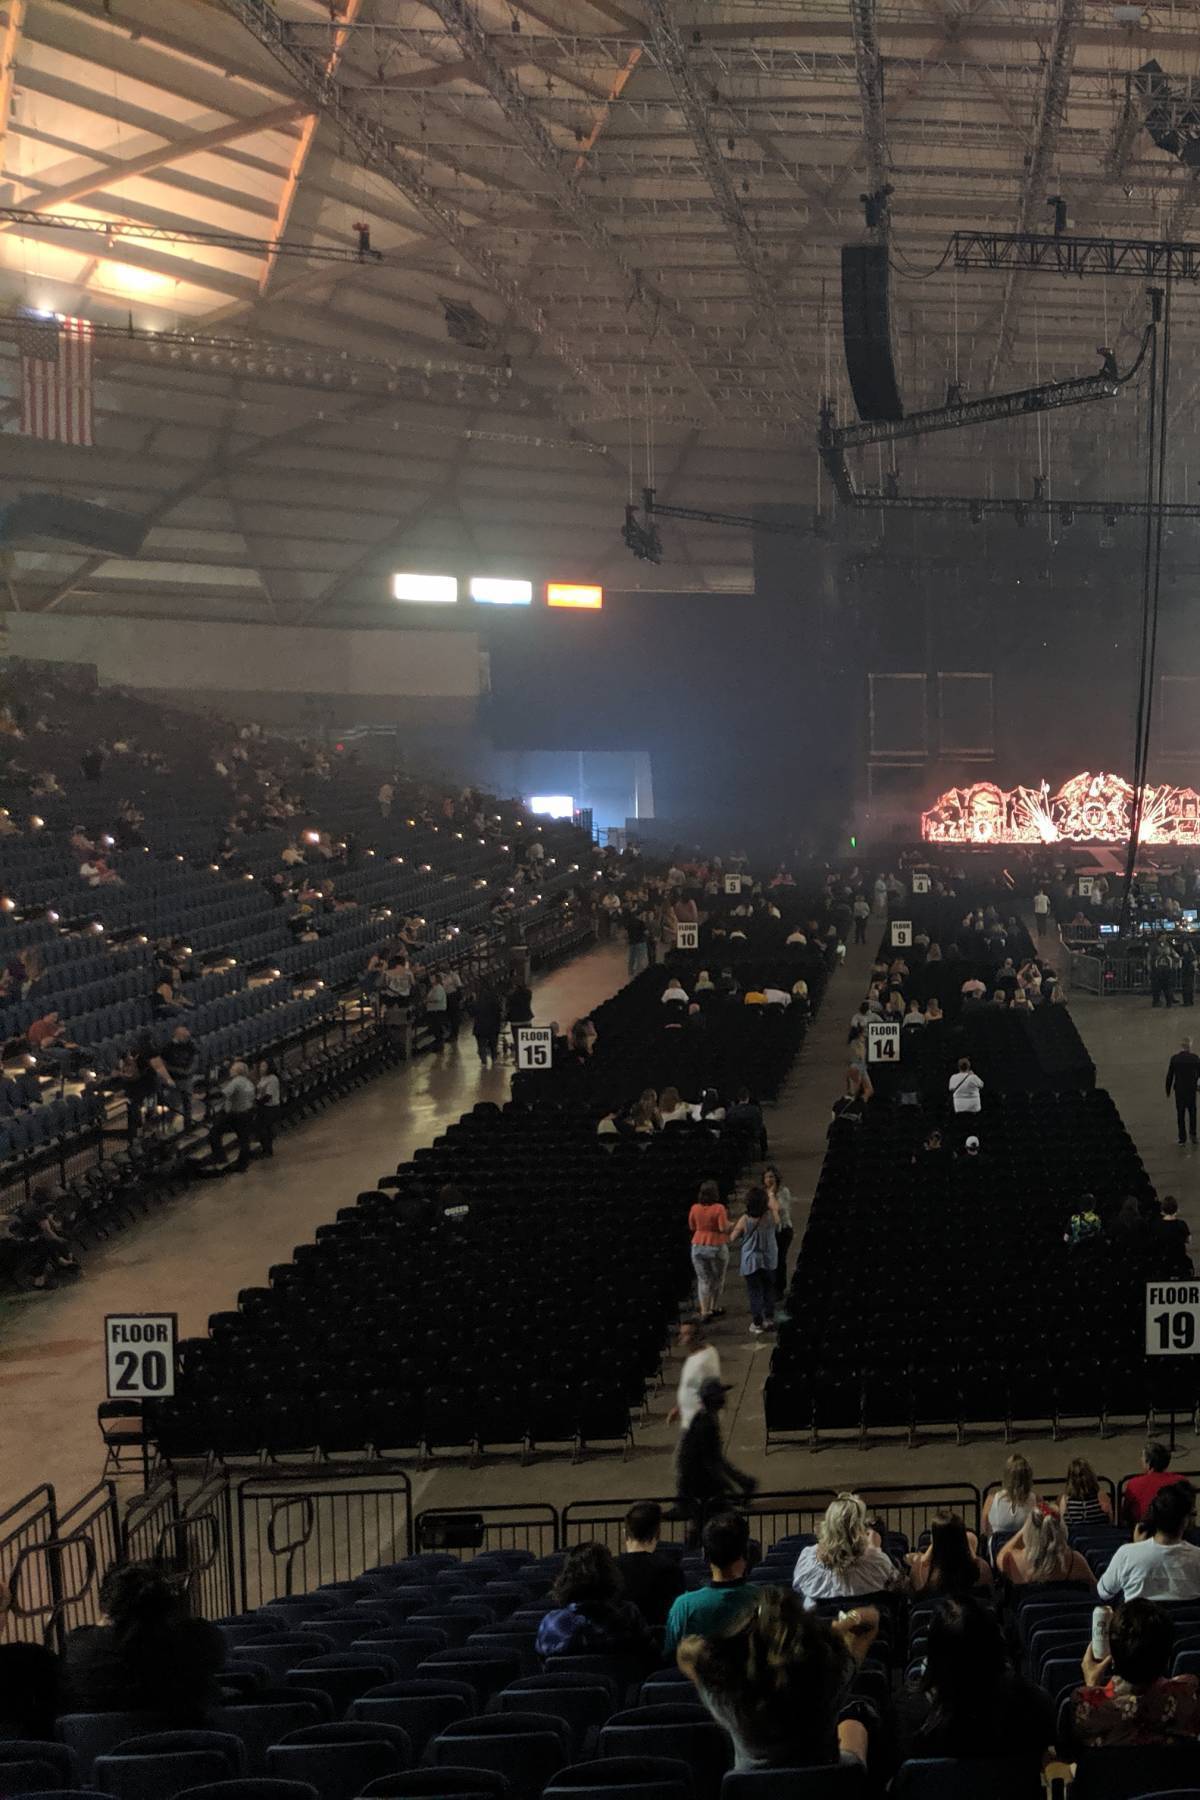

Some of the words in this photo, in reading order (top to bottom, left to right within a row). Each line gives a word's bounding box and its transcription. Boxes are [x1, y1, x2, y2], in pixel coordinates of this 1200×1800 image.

[730, 882, 736, 891] 5
[917, 882, 923, 891] 4
[1083, 884, 1089, 894] 3
[680, 933, 695, 946] 10
[898, 931, 906, 944] 9
[521, 1031, 549, 1041] FLOOR
[870, 1026, 898, 1036] FLOOR
[524, 1045, 547, 1065] 15
[873, 1039, 896, 1059] 14
[1150, 1287, 1199, 1305] FLOOR
[112, 1324, 168, 1343] FLOOR
[1154, 1311, 1195, 1349] 19
[115, 1351, 167, 1390] 20
